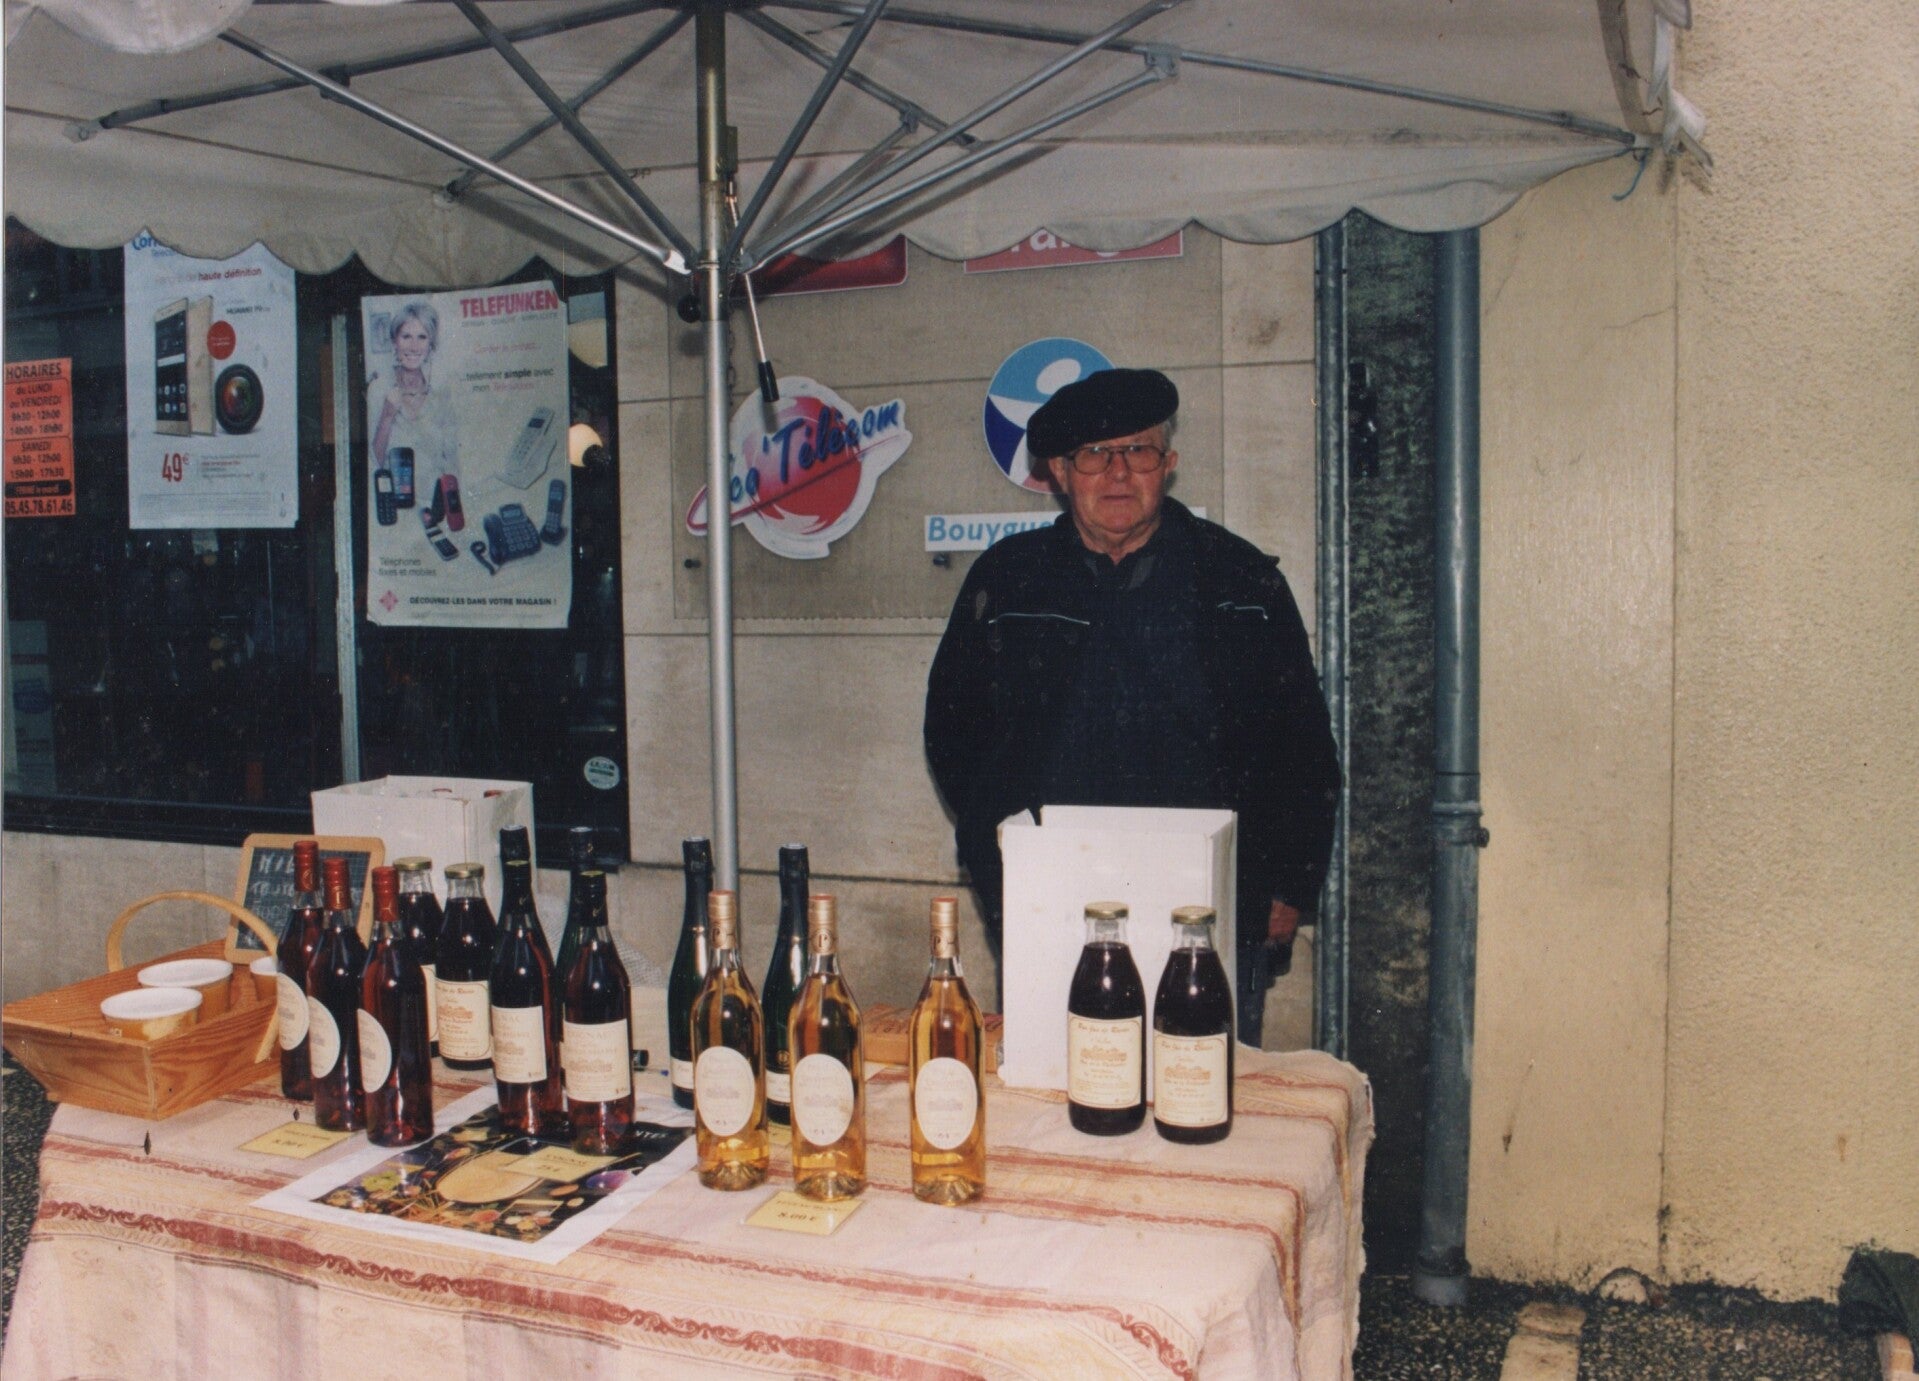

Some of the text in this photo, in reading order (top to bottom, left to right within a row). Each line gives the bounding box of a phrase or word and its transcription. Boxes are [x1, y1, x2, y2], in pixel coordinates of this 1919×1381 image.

[198, 270, 222, 281] haute
[224, 267, 262, 279] définition
[460, 289, 559, 318] TELEFUNKEN
[6, 362, 62, 379] HORAIRES
[504, 368, 532, 379] simple
[534, 368, 554, 377] avec
[15, 383, 53, 395] du LUNDI
[472, 384, 490, 392] mon
[9, 395, 62, 409] au VENDREDI
[37, 409, 60, 420] 12h00
[21, 441, 52, 452] SAMEDI
[12, 454, 31, 465] 9h30
[38, 452, 61, 464] 12h00
[380, 556, 421, 567] Téléphones
[379, 568, 436, 576] fixes et mobiles
[467, 597, 488, 605] DANS
[489, 597, 514, 606] VOTRE
[515, 597, 552, 606] MAGASIN
